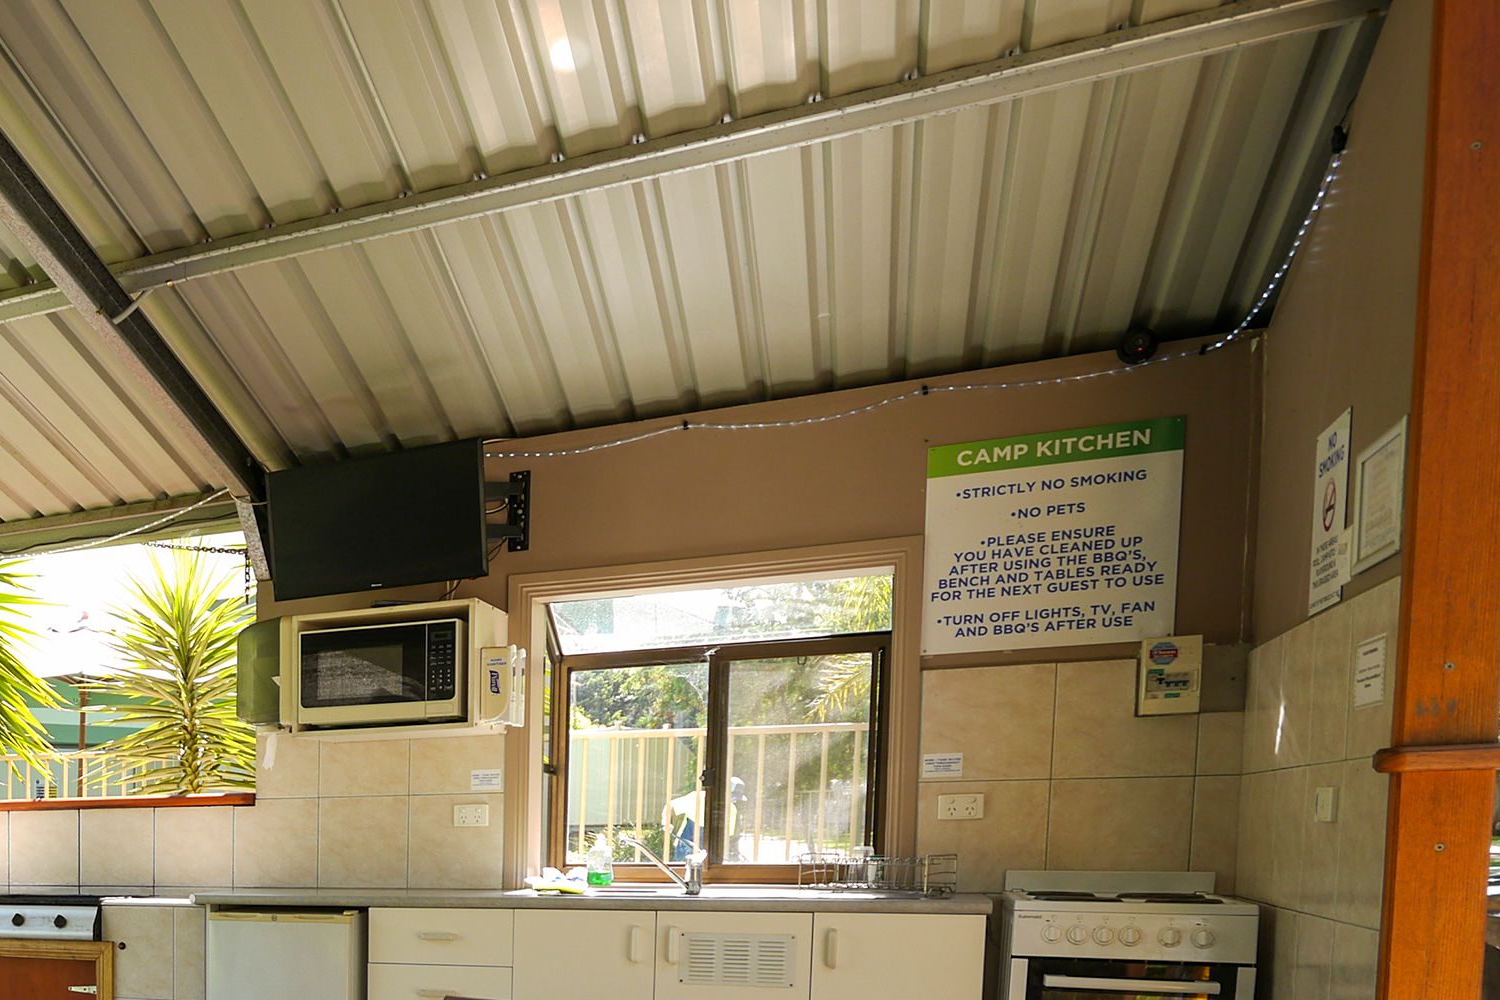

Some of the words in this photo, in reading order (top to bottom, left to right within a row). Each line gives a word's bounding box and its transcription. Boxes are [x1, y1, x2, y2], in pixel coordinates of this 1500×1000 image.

[957, 443, 1029, 467] CAMP
[1036, 428, 1151, 458] KITCHEN
[1328, 431, 1338, 450] NO
[1319, 444, 1345, 478] SMOKING
[1041, 479, 1065, 491] NO
[1070, 469, 1148, 489] SMOKING
[1046, 502, 1086, 517] PETS
[1051, 525, 1116, 542] ENSURE
[954, 551, 986, 563] YOU
[991, 546, 1034, 560] HAVE
[1039, 539, 1116, 555] CLEANED
[1121, 536, 1143, 548] UP
[938, 575, 990, 589] BENCH
[995, 572, 1029, 585] AND
[1034, 566, 1095, 581] TABLES
[1100, 561, 1158, 576] READY
[948, 562, 998, 576] AFTER
[1004, 557, 1051, 571] USING
[1057, 554, 1087, 567] THE
[1093, 549, 1147, 564] BBQ'S,
[931, 590, 962, 602] FOR
[966, 587, 996, 599] THE
[1001, 583, 1043, 597] NEXT
[1046, 579, 1100, 593] GUEST
[1104, 576, 1127, 588] TO
[1132, 574, 1165, 586] USE
[989, 610, 1021, 623] OFF
[1025, 606, 1085, 621] LIGHTS,
[1090, 604, 1116, 616] TV,
[1121, 601, 1156, 613] FAN
[954, 626, 988, 638] AND
[993, 622, 1040, 635] BBQ'S
[1044, 618, 1097, 632] AFTER
[1102, 615, 1133, 628] USE
